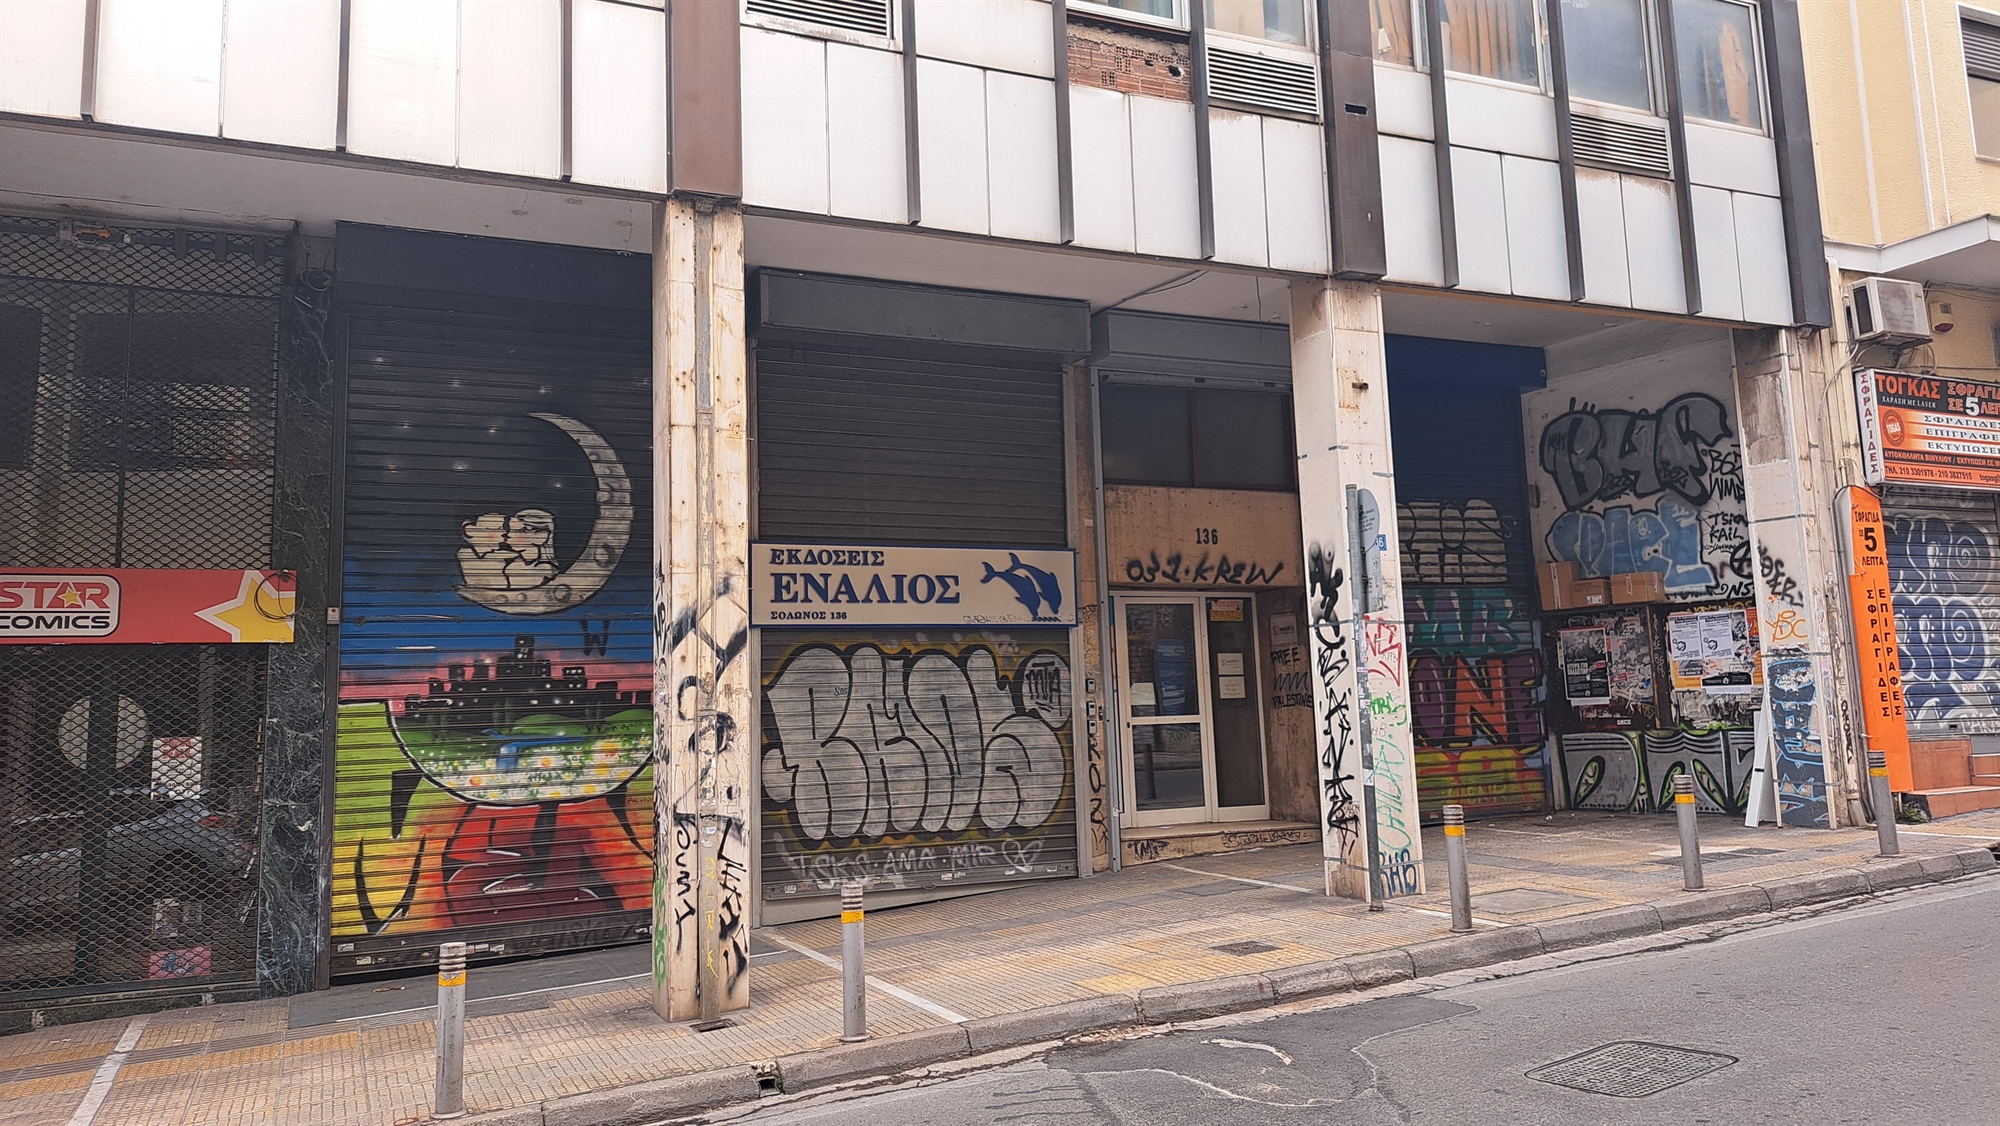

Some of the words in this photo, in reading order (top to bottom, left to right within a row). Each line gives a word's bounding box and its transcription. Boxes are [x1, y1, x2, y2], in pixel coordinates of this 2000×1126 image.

[1876, 374, 1940, 399] ΤΟΓΚΑΣ
[1947, 398, 1964, 411] ΣΕ
[1965, 396, 1980, 416] 5
[1860, 373, 1878, 474] ΣΦΡΑΓΙΔΕΣ
[1899, 466, 1910, 475] 210
[1938, 469, 1949, 479] 210
[1854, 511, 1880, 523] ΣΦΡΑΓΙΔΑ
[1195, 528, 1219, 545] 136
[1864, 527, 1877, 552] 5
[769, 548, 885, 566] ΕΚΔΟΣΕΙΣ
[1861, 556, 1884, 566] ΛΕΠΤΑ
[0, 582, 110, 608] STAR
[770, 573, 960, 604] ΕΝΑΛΙΟΣ
[770, 611, 826, 621] ΣΟΛΩΝΟΣ
[830, 611, 848, 621] 136
[1270, 646, 1301, 666] FREE
[1866, 588, 1890, 718] ΣΦΡΑΓΙΔΕΣ
[1878, 588, 1902, 716] ΕΠΙΓΡΑΦΕΣ
